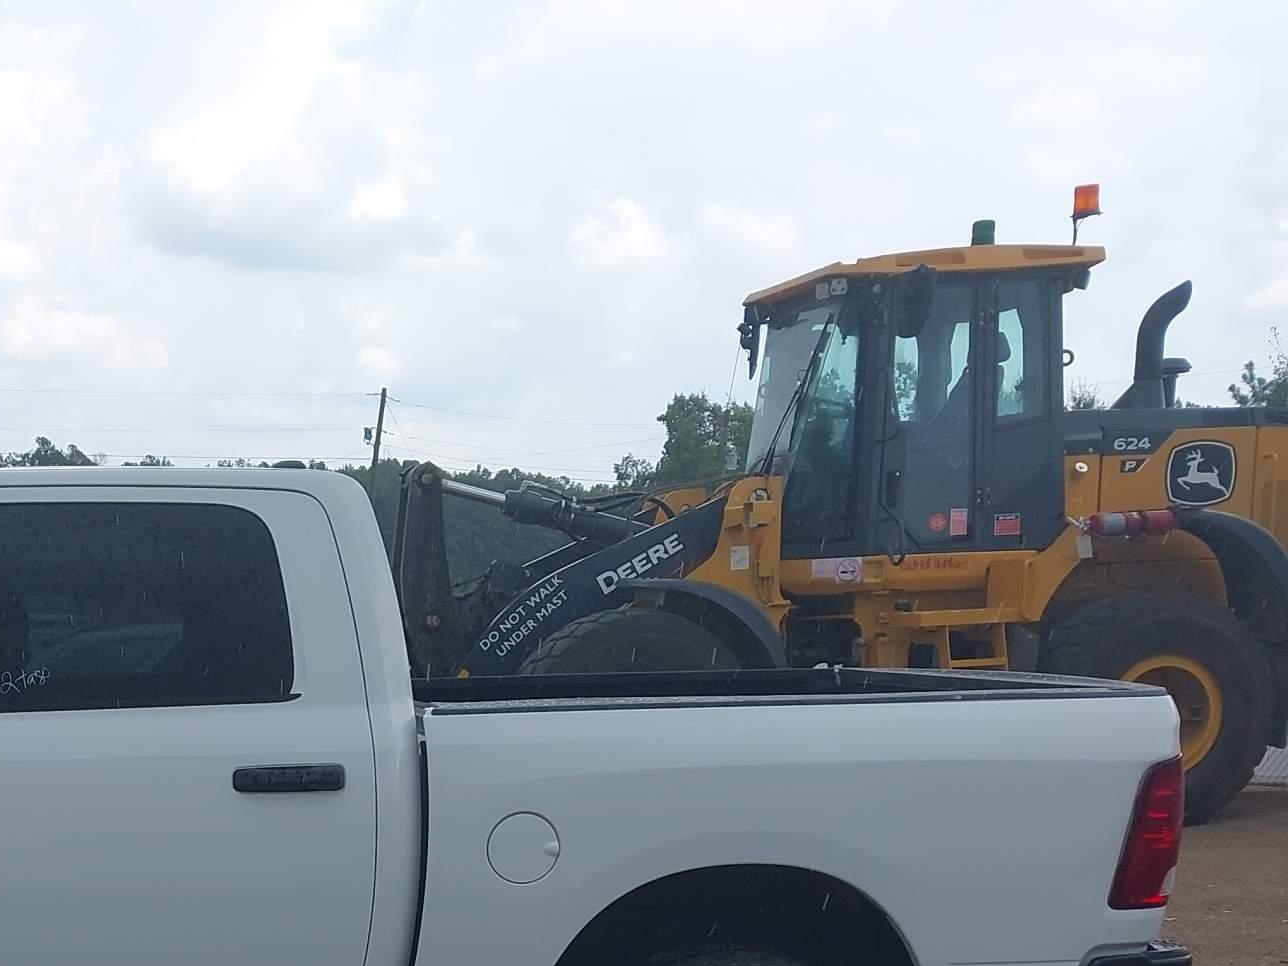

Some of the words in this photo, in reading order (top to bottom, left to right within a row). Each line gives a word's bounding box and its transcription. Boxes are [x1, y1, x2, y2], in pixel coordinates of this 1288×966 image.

[1113, 437, 1151, 450] 624
[1124, 460, 1137, 472] P
[595, 533, 684, 596] DEERE
[479, 631, 500, 651] DO
[499, 605, 529, 633] NOT
[526, 574, 564, 608] WALK
[496, 619, 538, 657] UNDER
[536, 589, 568, 621] MAST
